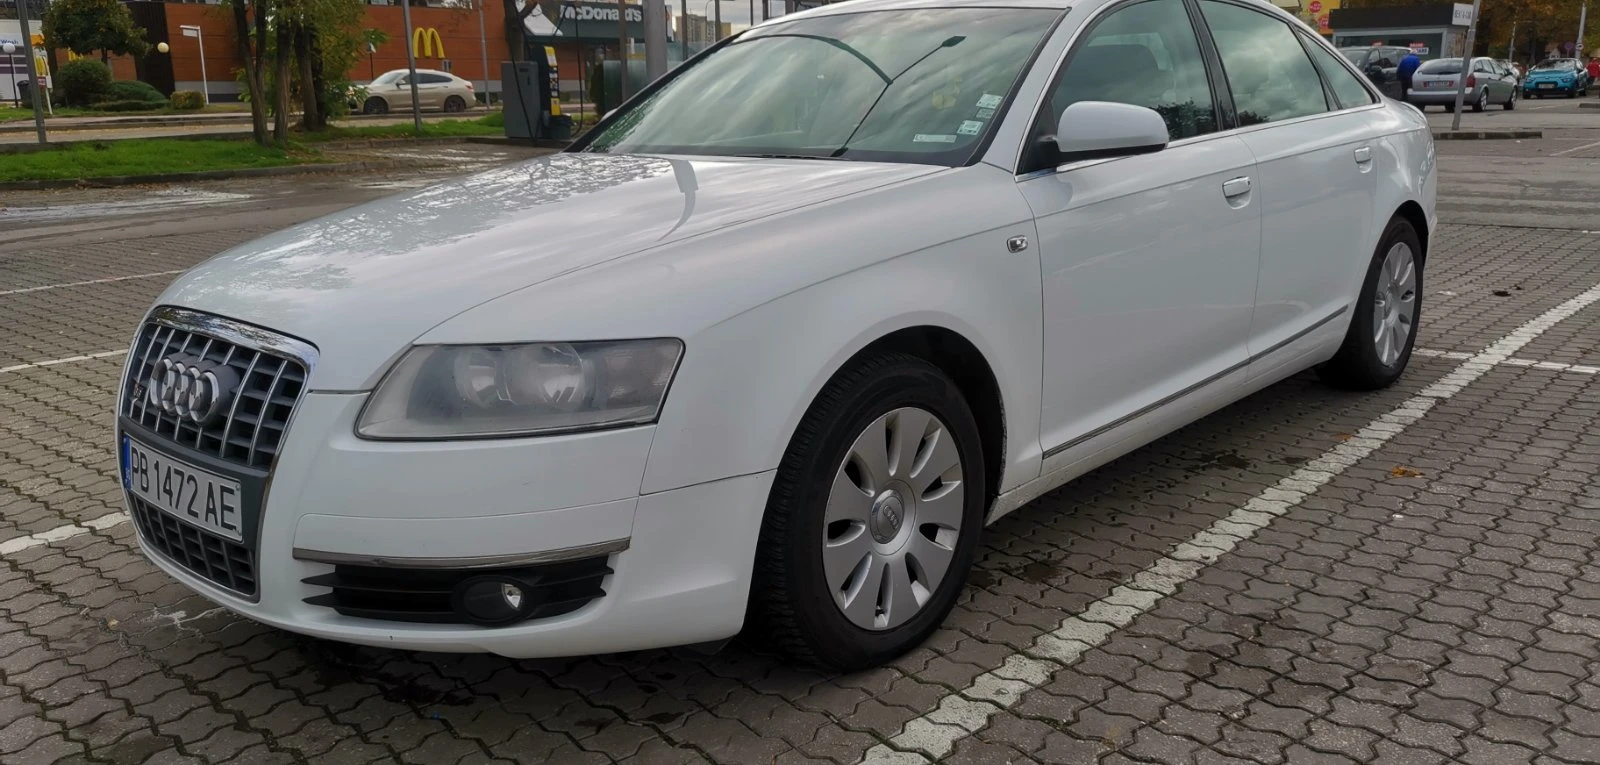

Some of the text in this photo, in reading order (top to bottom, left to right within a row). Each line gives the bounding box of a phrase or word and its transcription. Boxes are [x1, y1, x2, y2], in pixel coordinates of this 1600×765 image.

[560, 5, 642, 22] McDonad's
[131, 446, 236, 531] PB 1472 AE
